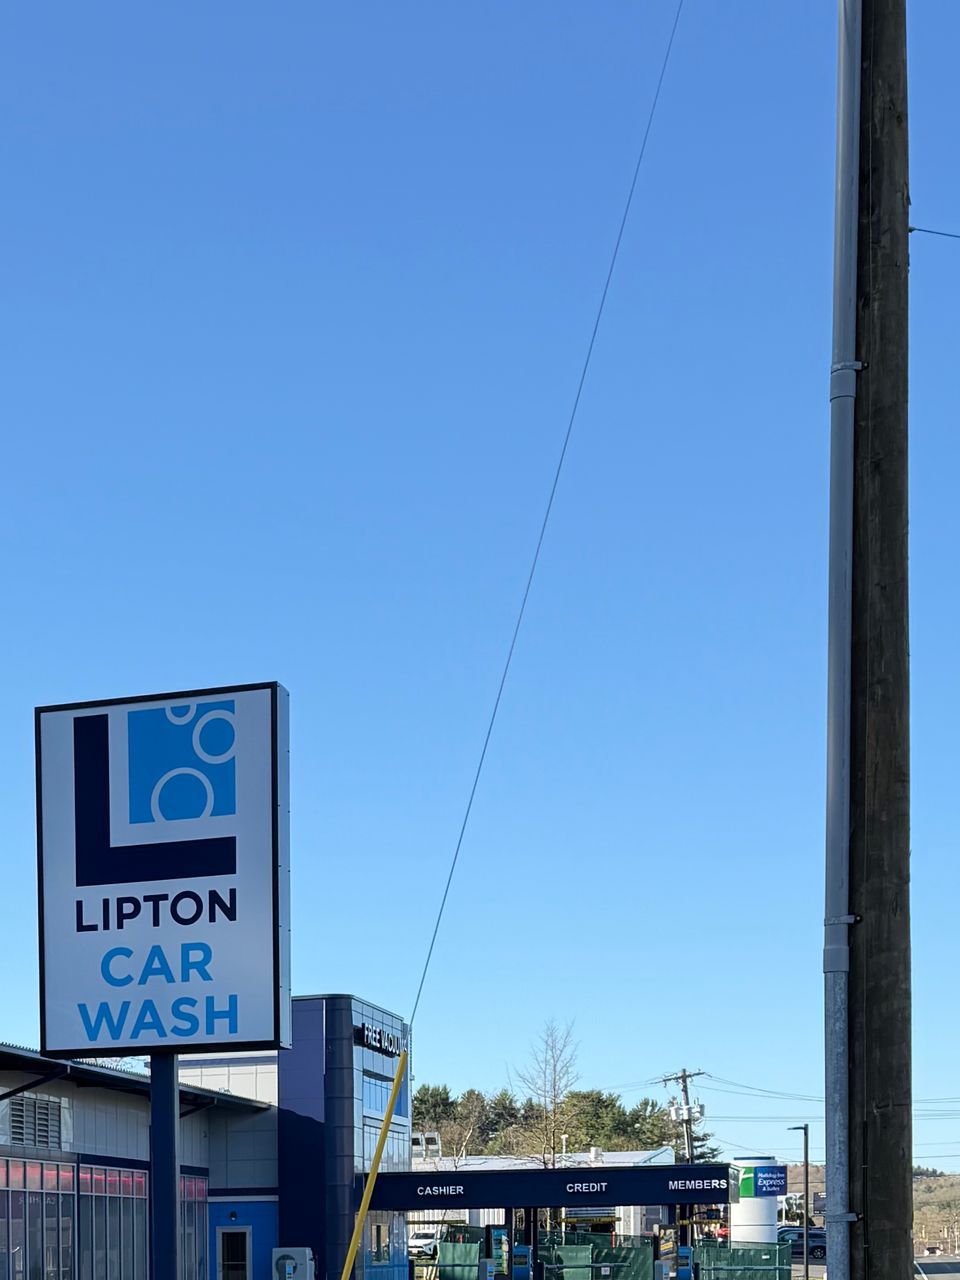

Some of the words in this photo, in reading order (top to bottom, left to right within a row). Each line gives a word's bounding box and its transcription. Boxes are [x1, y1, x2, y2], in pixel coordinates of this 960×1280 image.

[75, 887, 237, 933] LIPTON
[100, 942, 214, 987] CAR
[76, 994, 239, 1042] WASH
[365, 1023, 380, 1047] FREE
[417, 1186, 465, 1196] CASHIER
[566, 1182, 608, 1193] CREDIT
[668, 1179, 728, 1190] MEMBERS
[758, 1178, 785, 1187] Express
